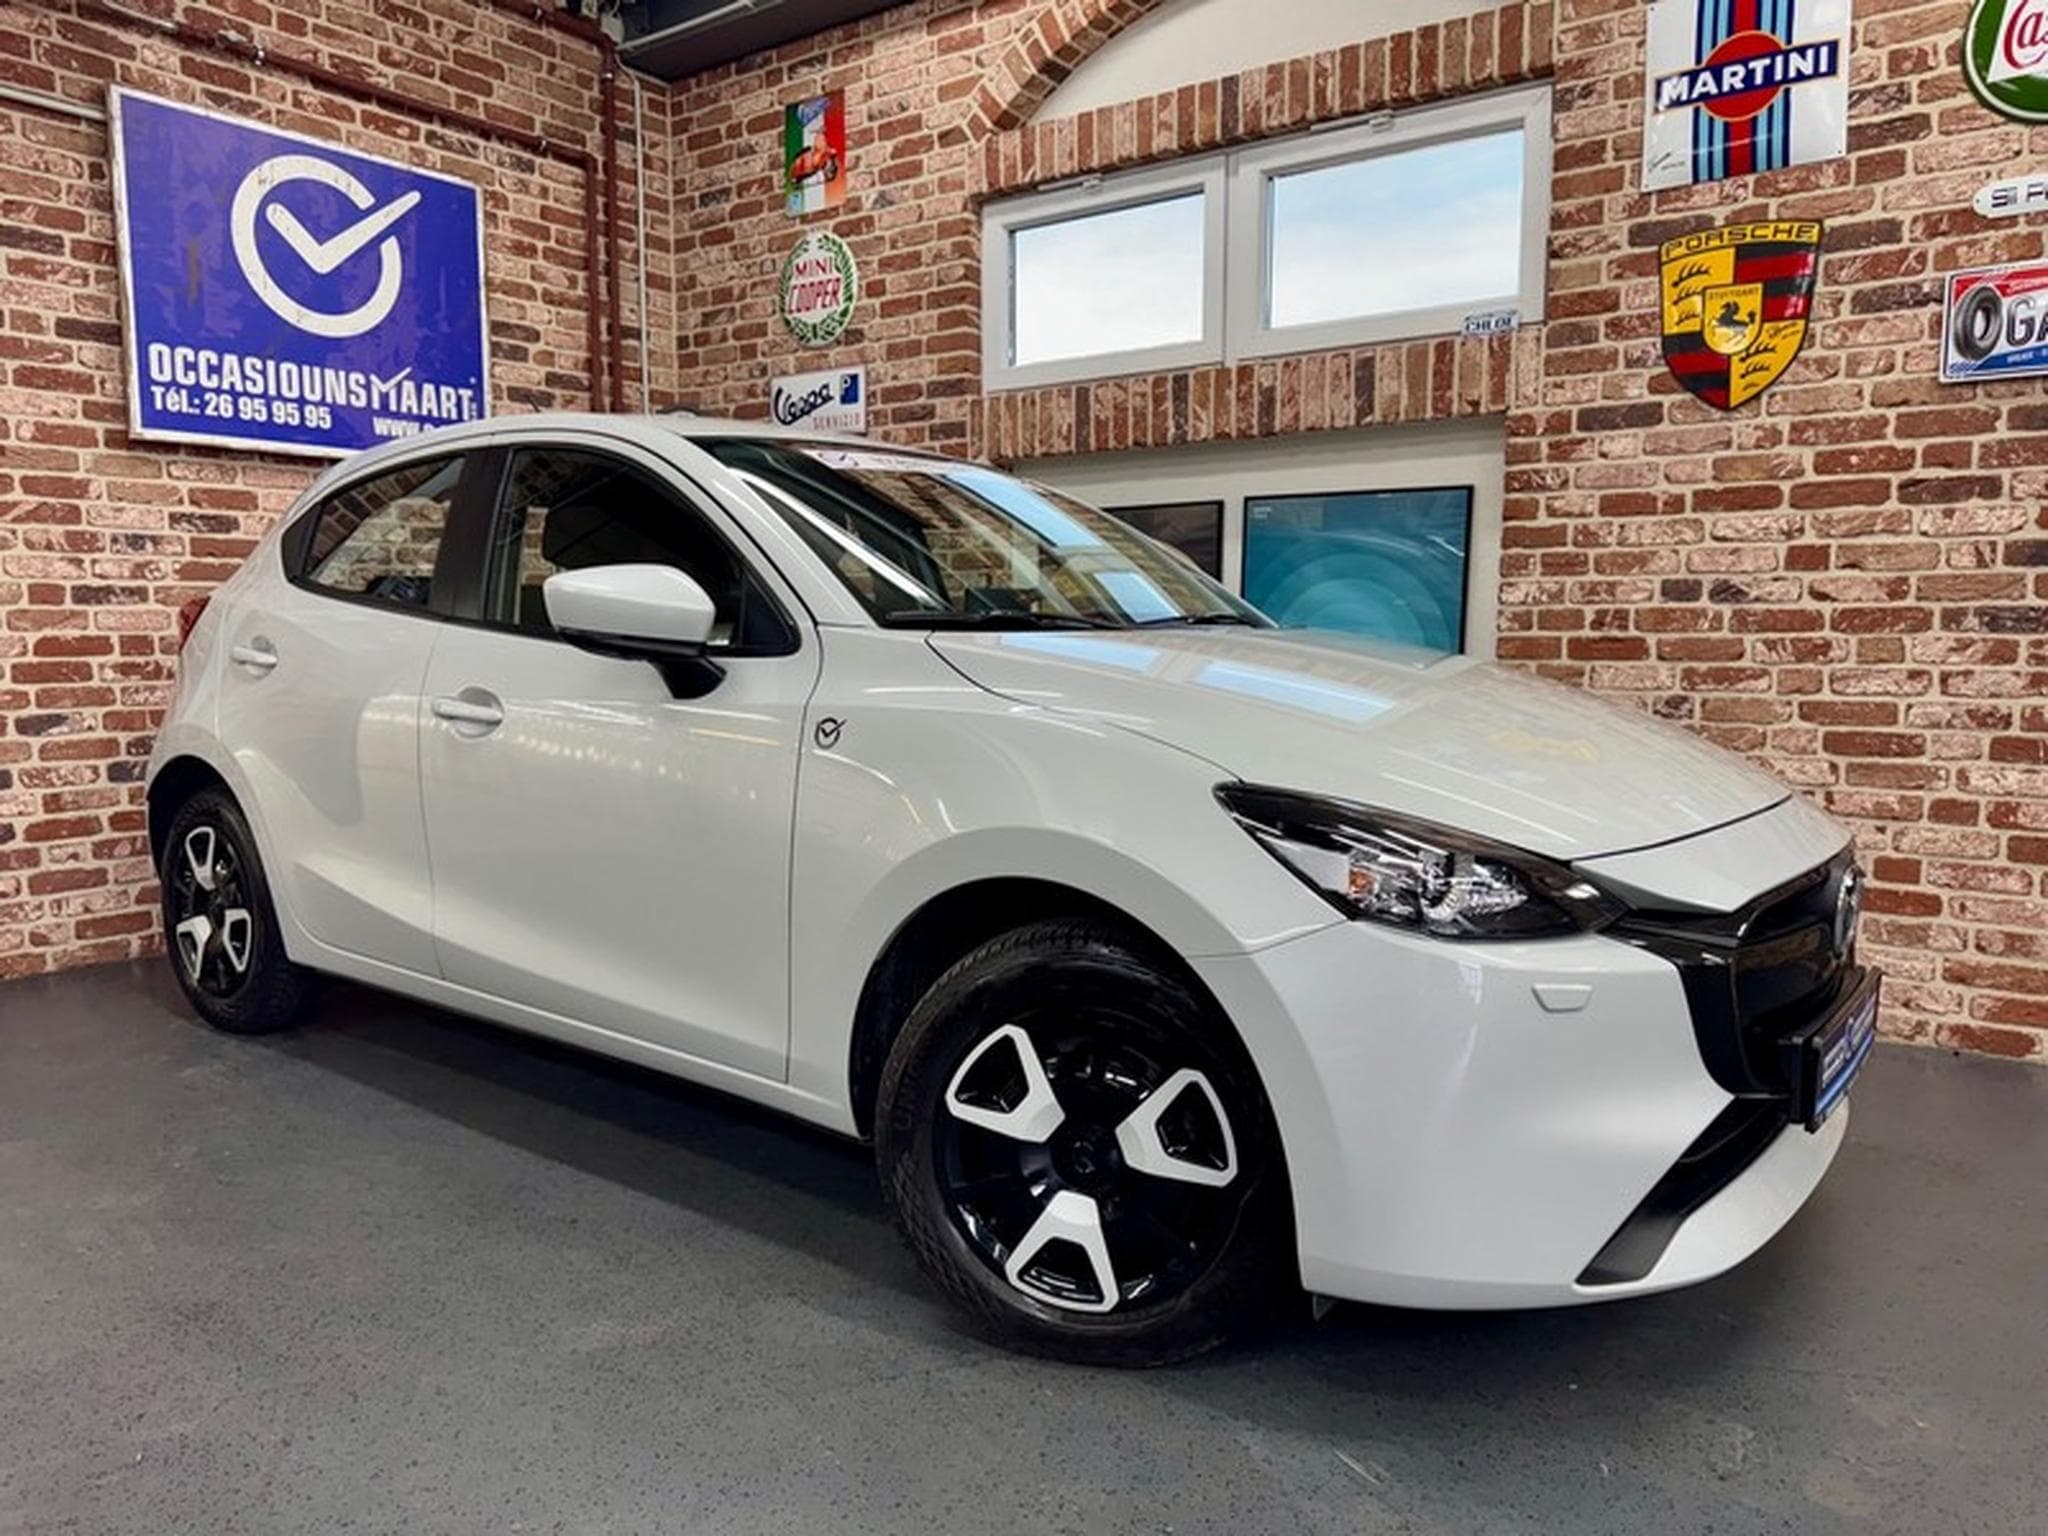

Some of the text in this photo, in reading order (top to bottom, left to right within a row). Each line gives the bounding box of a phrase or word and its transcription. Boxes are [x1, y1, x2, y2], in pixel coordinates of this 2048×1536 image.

[1658, 45, 1830, 111] MARTINI
[1664, 222, 1816, 259] PORSCHE
[795, 256, 833, 278] MINI
[787, 277, 841, 315] COOPER
[150, 385, 333, 431] Tél.: 26 95 95 95
[774, 383, 835, 426] Vespa
